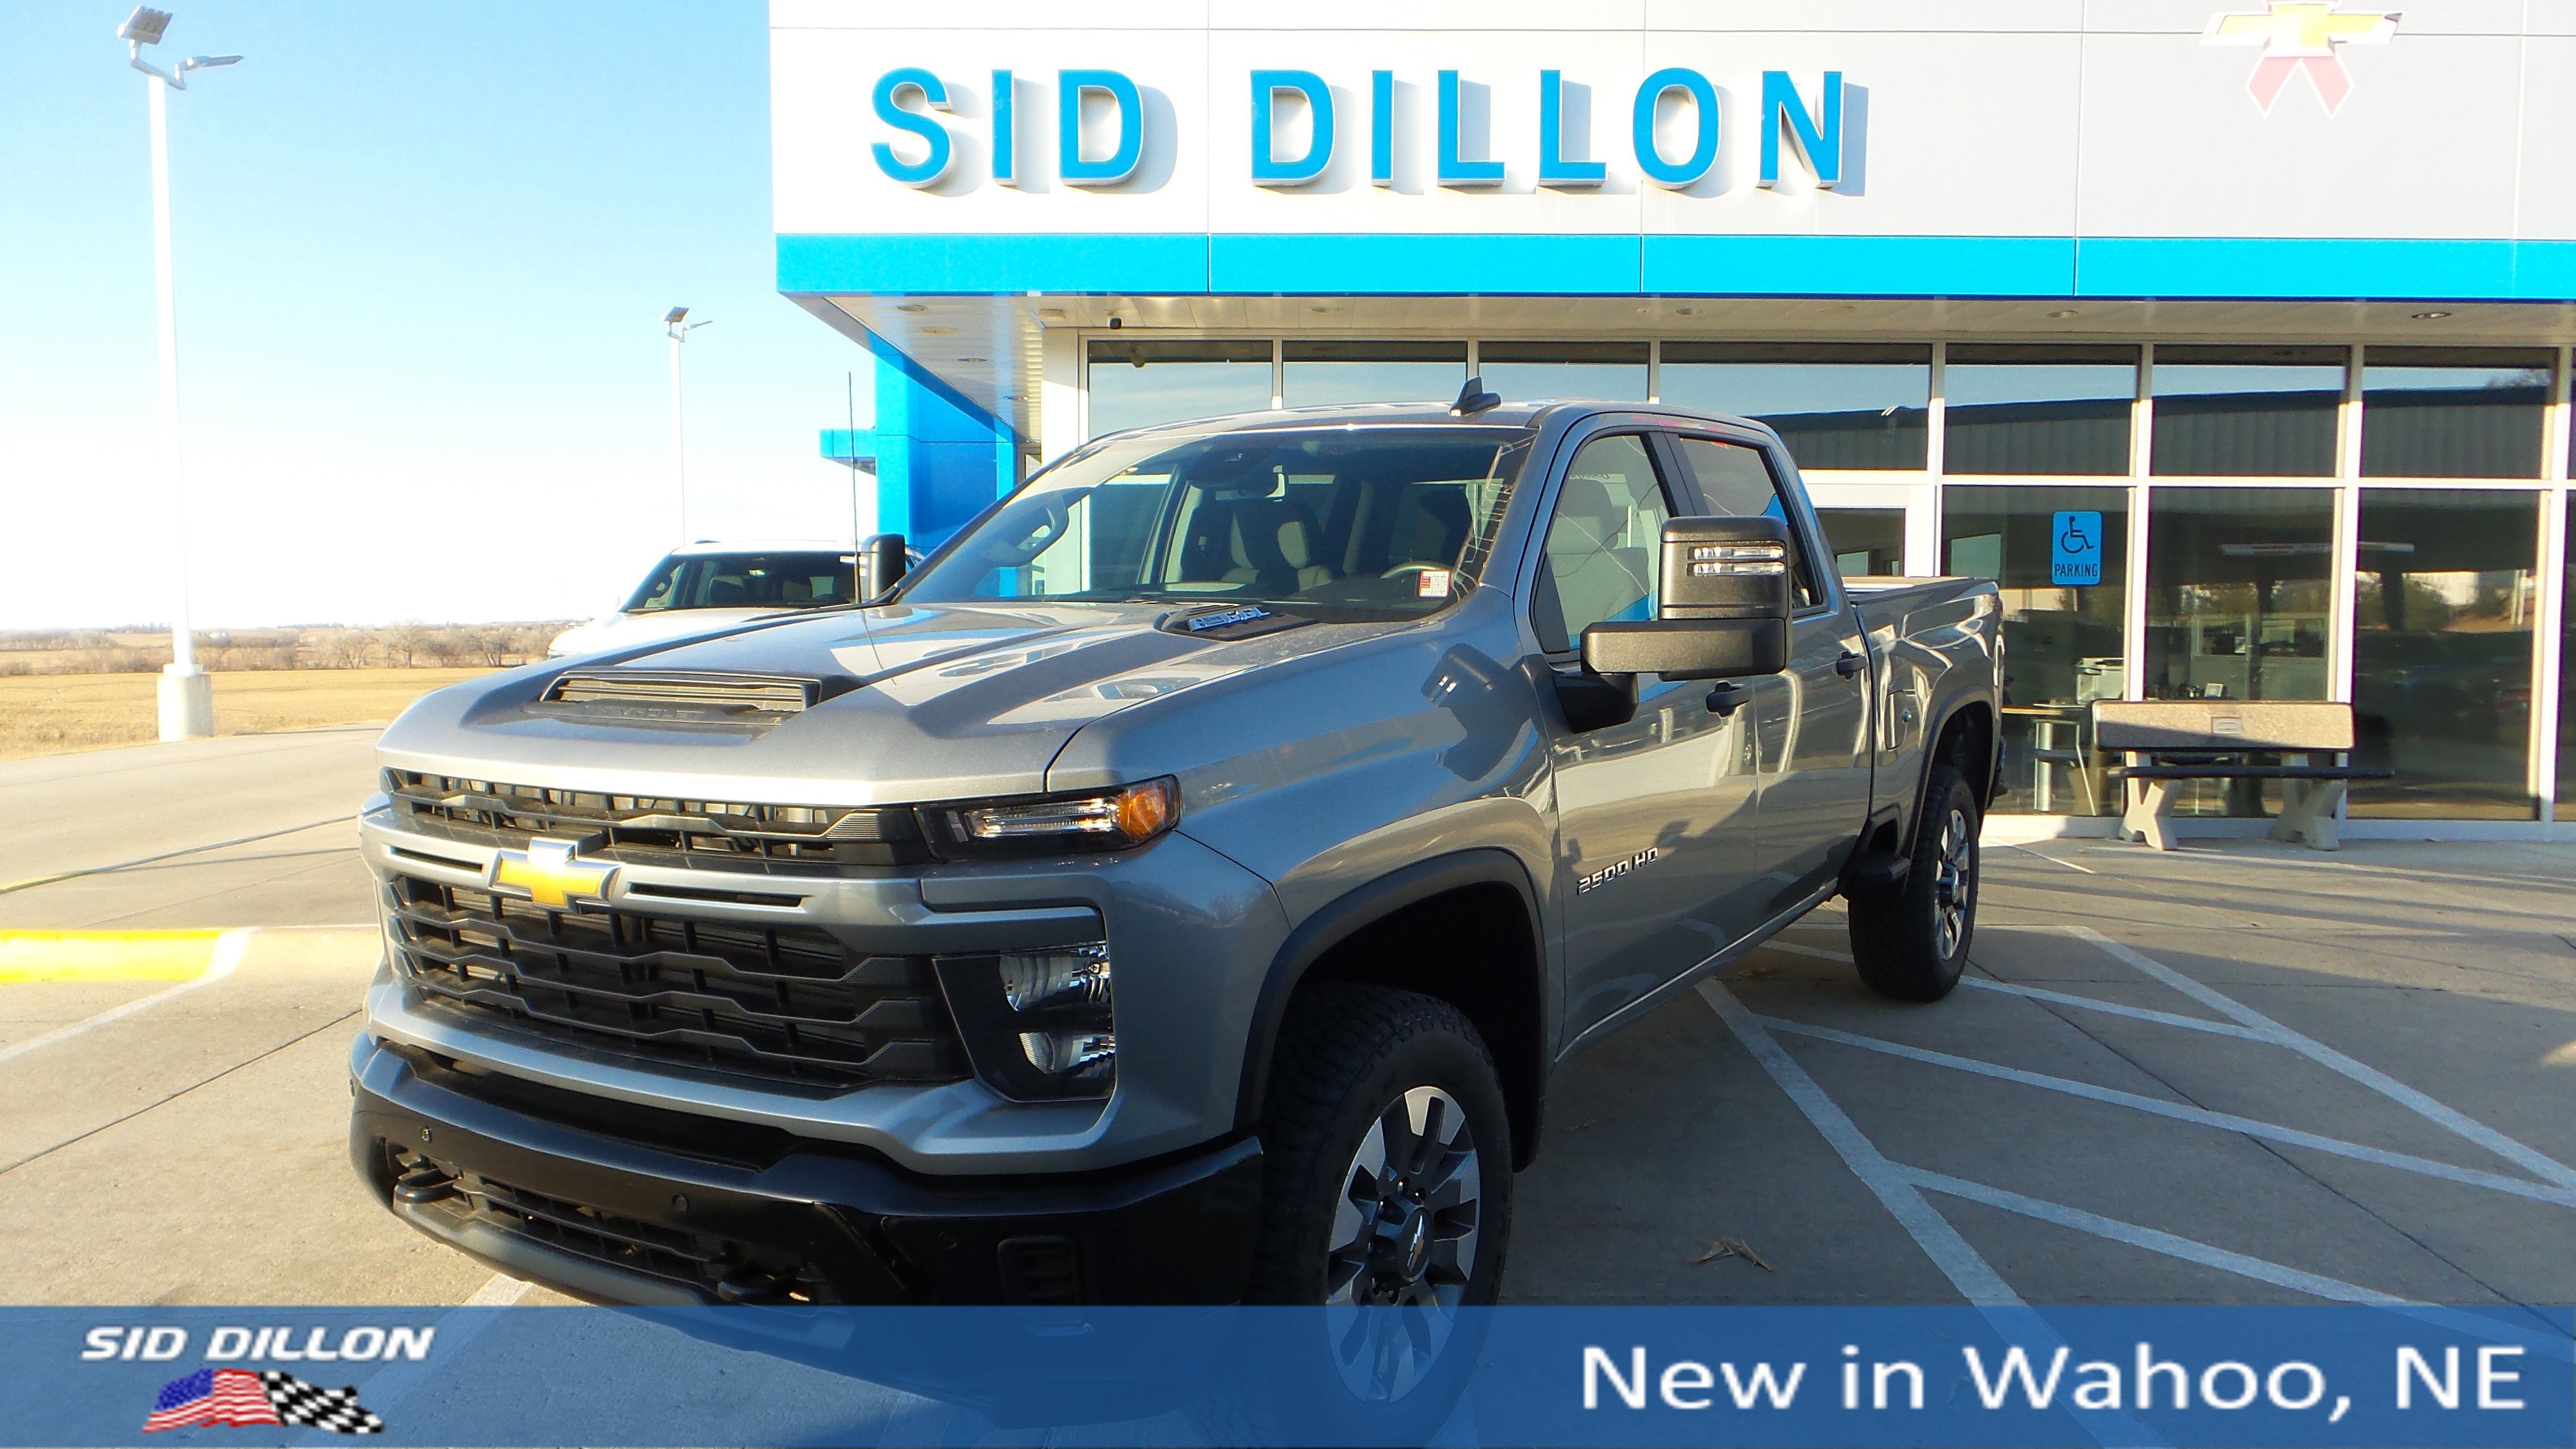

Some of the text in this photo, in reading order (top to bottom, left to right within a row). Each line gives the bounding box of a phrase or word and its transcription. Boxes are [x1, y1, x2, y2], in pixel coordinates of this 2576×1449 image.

[871, 67, 1844, 188] SID DILLON
[2054, 563, 2099, 577] PARKING
[1576, 846, 1659, 896] 2500 HD
